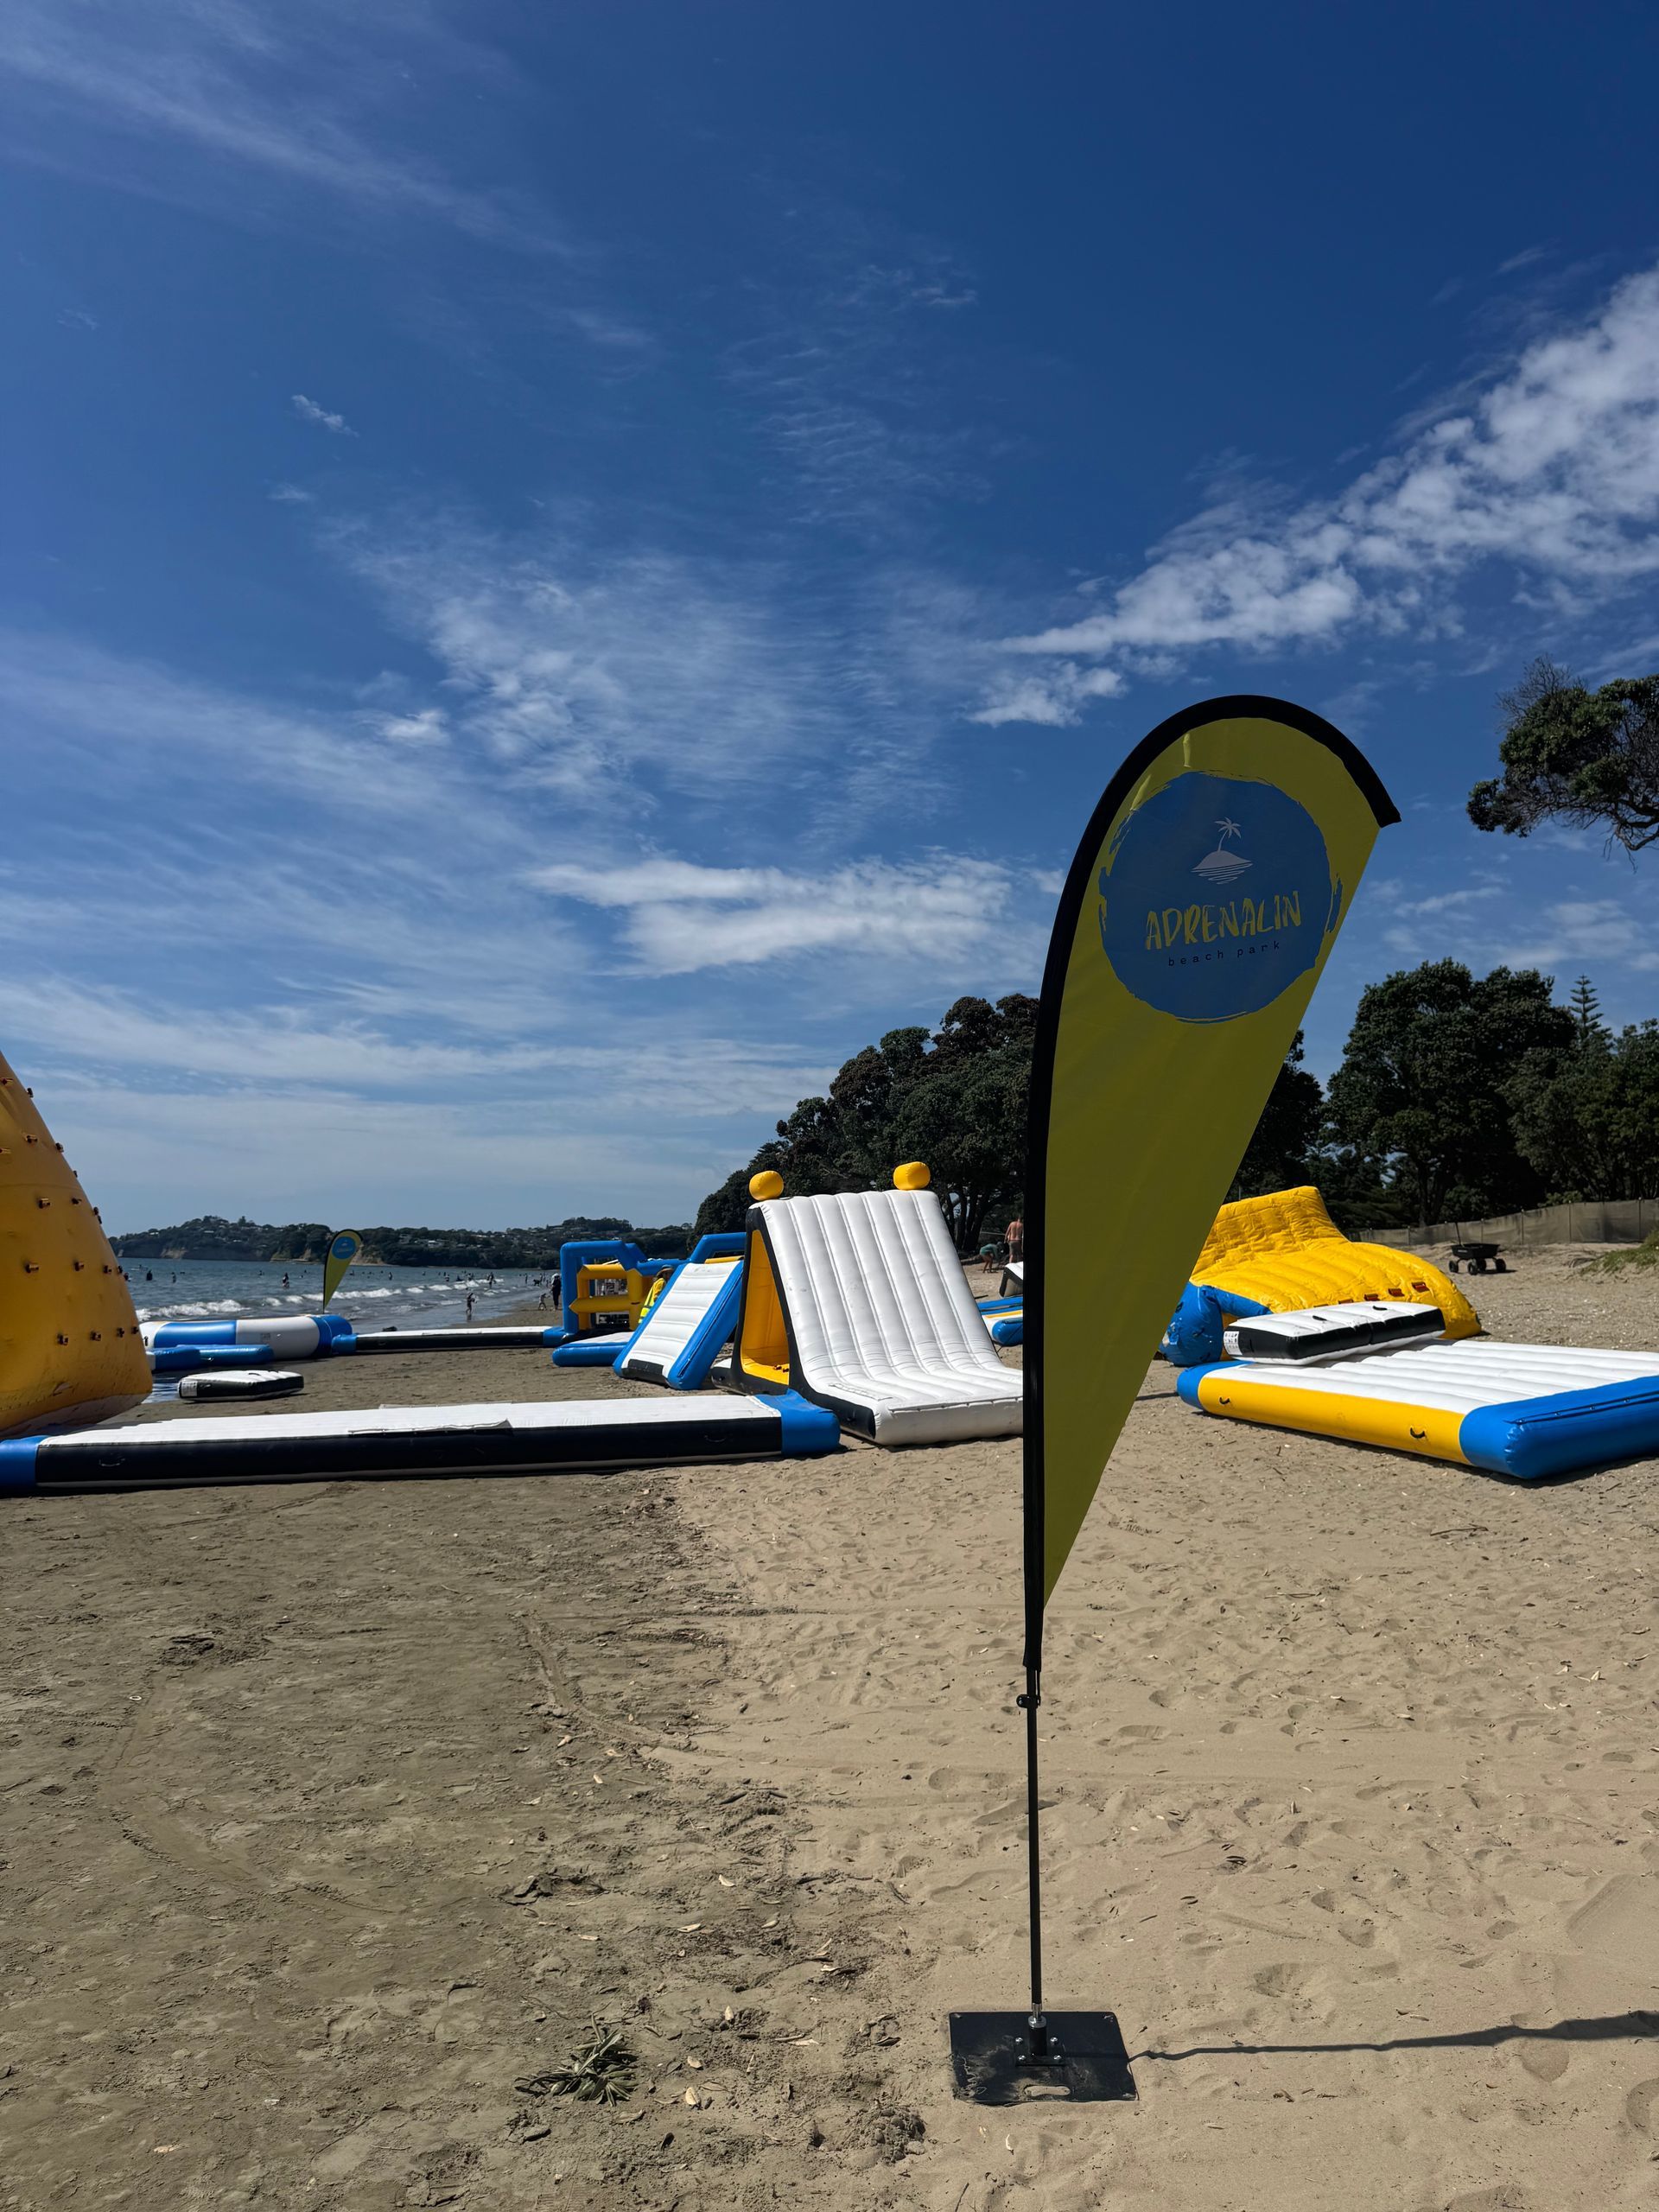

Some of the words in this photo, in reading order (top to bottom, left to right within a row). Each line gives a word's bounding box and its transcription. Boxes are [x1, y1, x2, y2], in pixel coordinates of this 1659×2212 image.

[1145, 891, 1301, 950] ADRENALIN
[1168, 950, 1224, 966] beach
[1236, 941, 1280, 957] park
